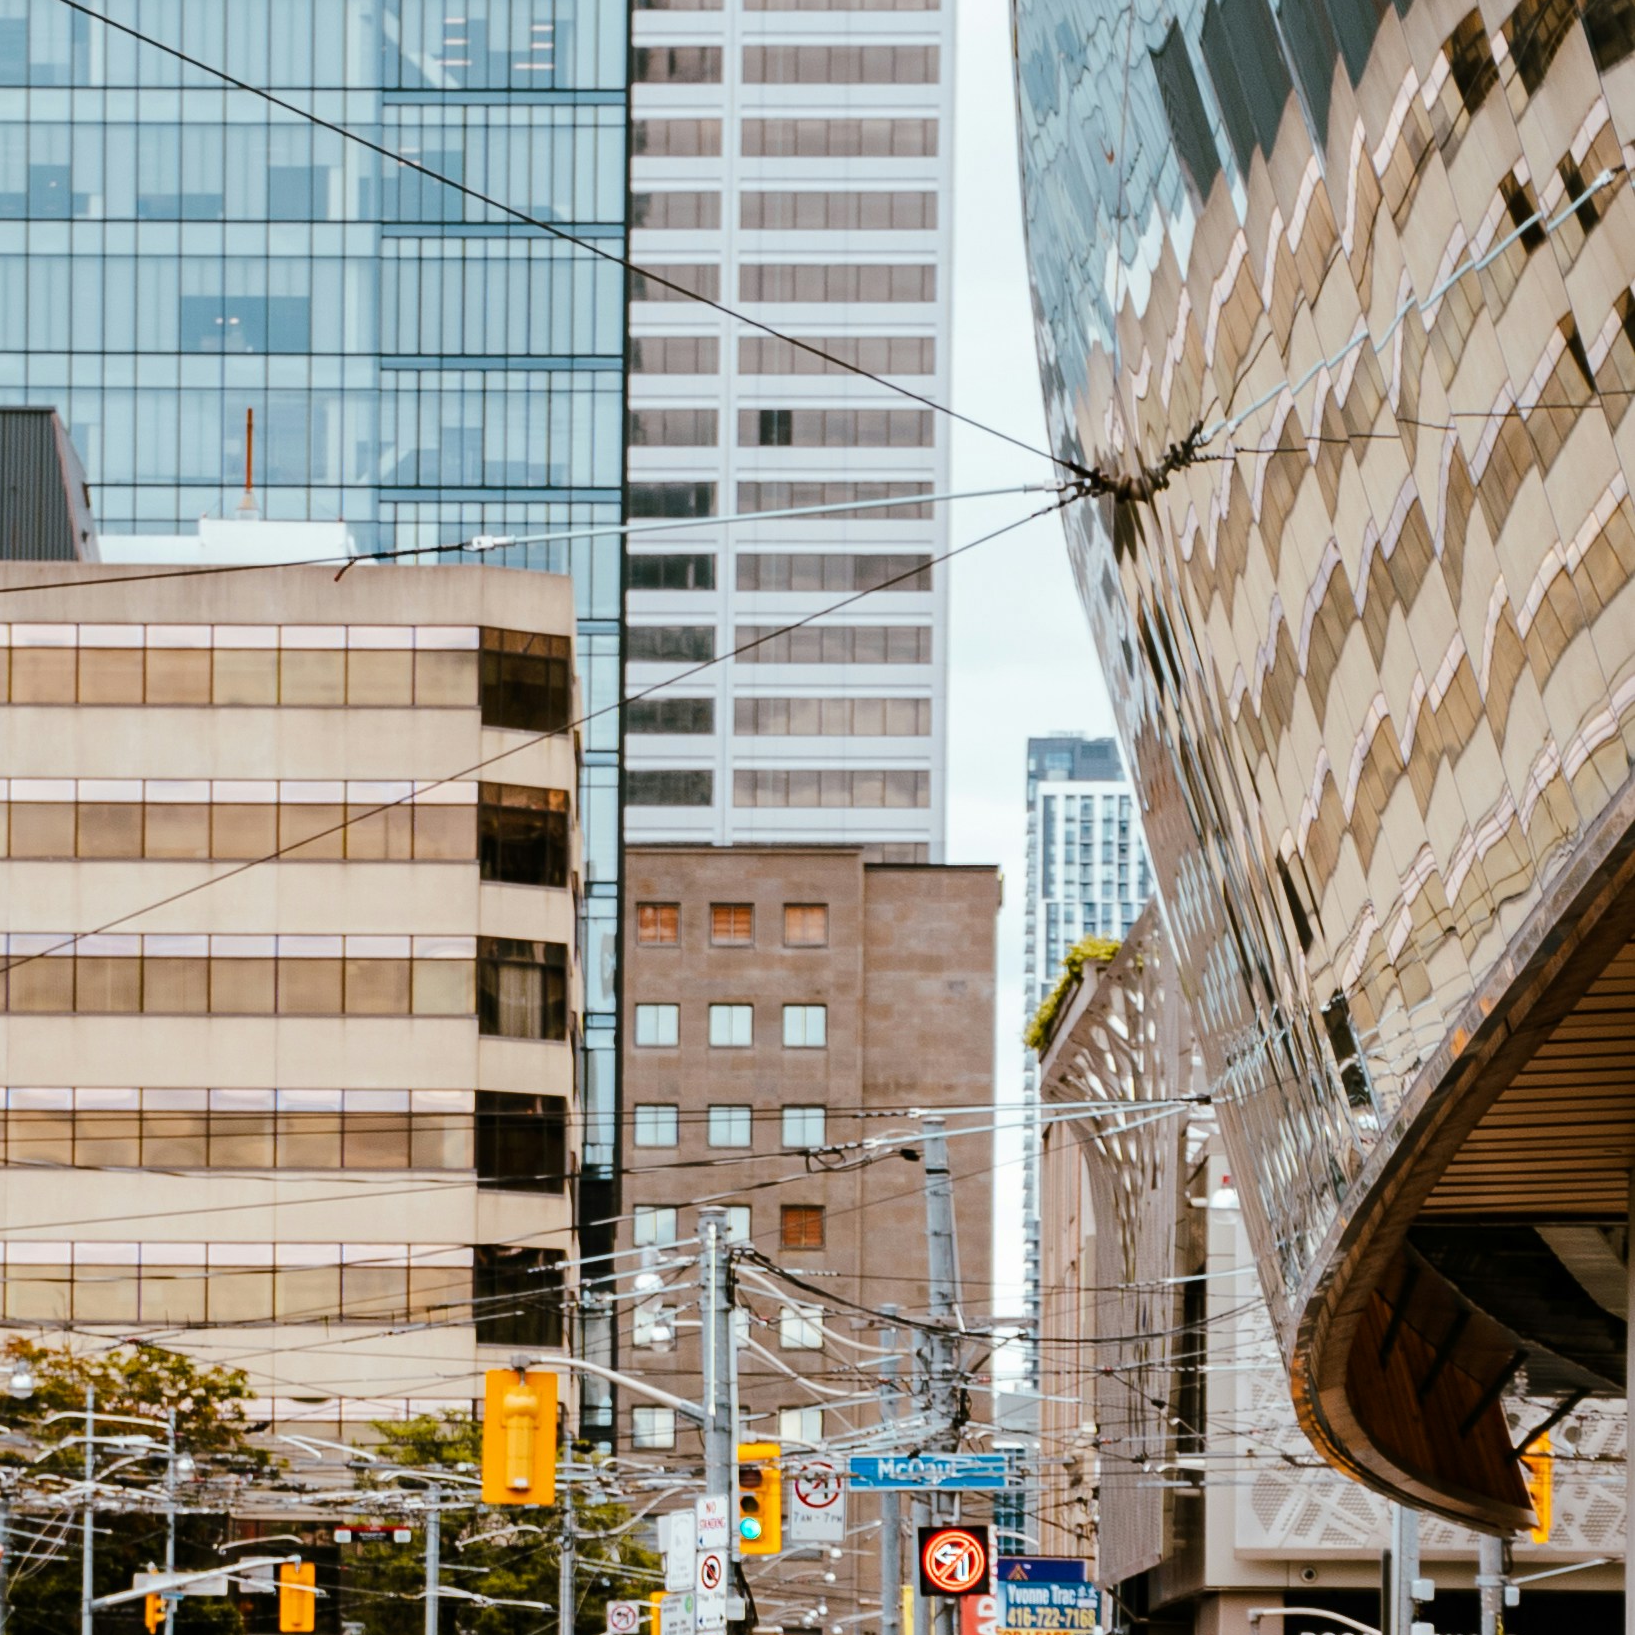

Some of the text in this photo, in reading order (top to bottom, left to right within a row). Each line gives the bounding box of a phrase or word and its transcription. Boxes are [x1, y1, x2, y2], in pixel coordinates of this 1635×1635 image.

[794, 1512, 812, 1523] 7AM
[824, 1512, 843, 1524] 7PM
[1007, 1584, 1050, 1605] Yvonne
[1050, 1584, 1076, 1605] Trac
[1007, 1607, 1096, 1628] 416-722-7168
